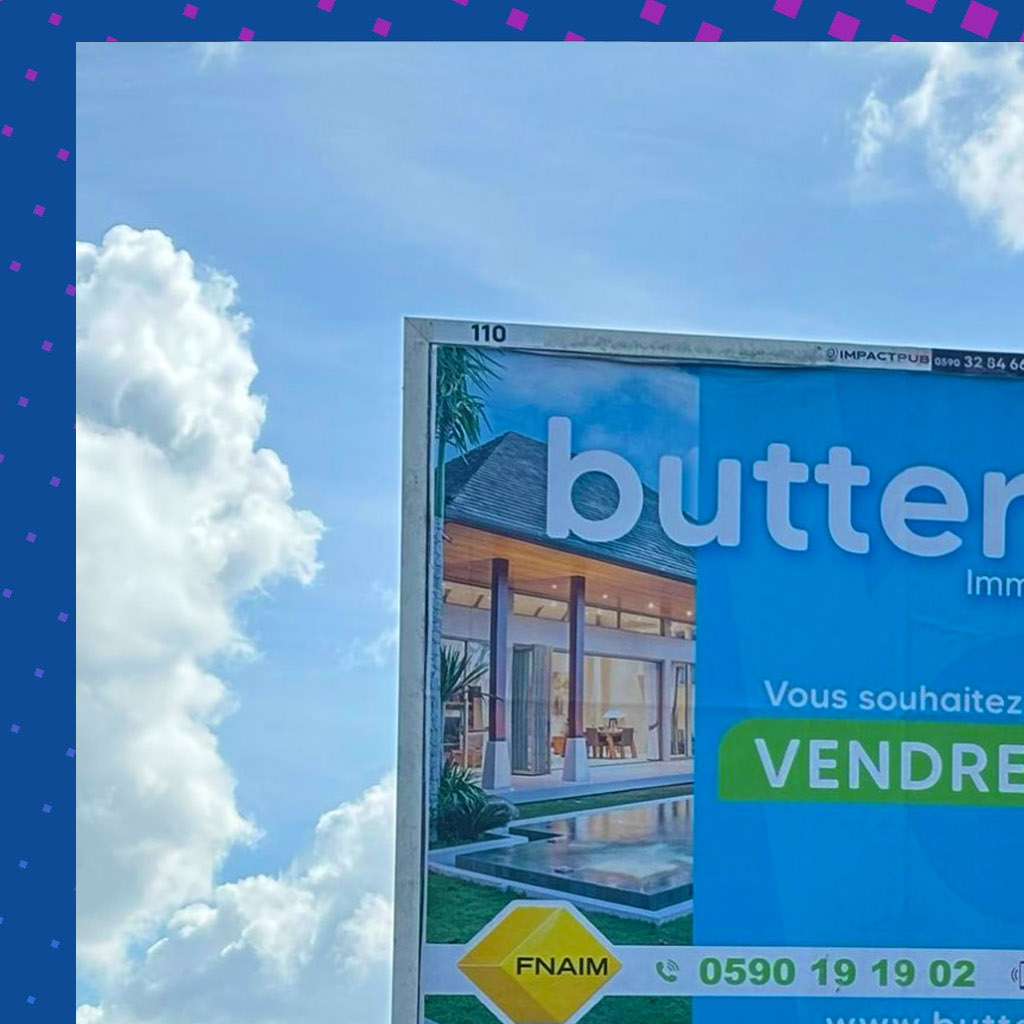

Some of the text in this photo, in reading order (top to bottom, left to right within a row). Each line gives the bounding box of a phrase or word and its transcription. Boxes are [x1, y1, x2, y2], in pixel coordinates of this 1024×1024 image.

[471, 324, 506, 344] 110
[839, 348, 931, 365] IMPACTPUB
[934, 357, 961, 368] 0590
[963, 355, 983, 369] 32
[987, 356, 1006, 371] 84
[763, 679, 1023, 715] Vous souhaitez
[516, 956, 608, 977] FNAIM
[699, 956, 976, 988] 0590 19 19 02
